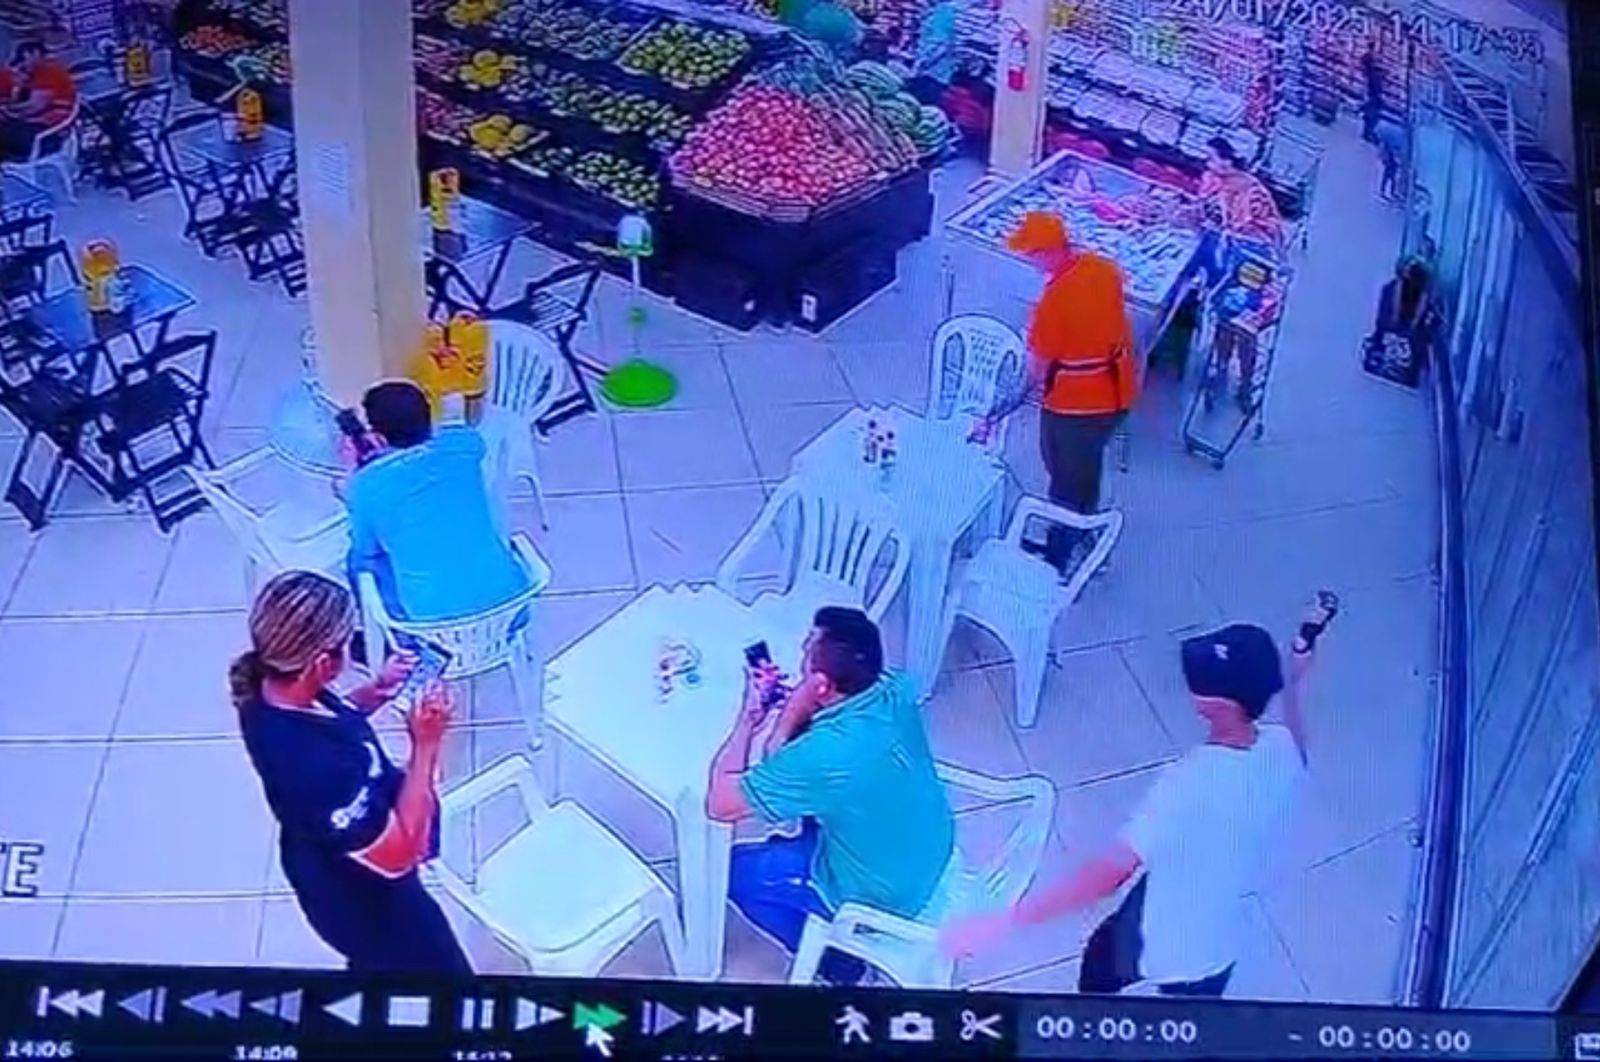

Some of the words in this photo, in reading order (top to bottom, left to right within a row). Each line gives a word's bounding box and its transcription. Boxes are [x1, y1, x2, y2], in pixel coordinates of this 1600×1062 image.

[0, 841, 45, 898] E
[5, 1039, 74, 1058] 14:06
[1036, 1015, 1198, 1043] 00:00:00
[1318, 1025, 1472, 1051] 00:00:00
